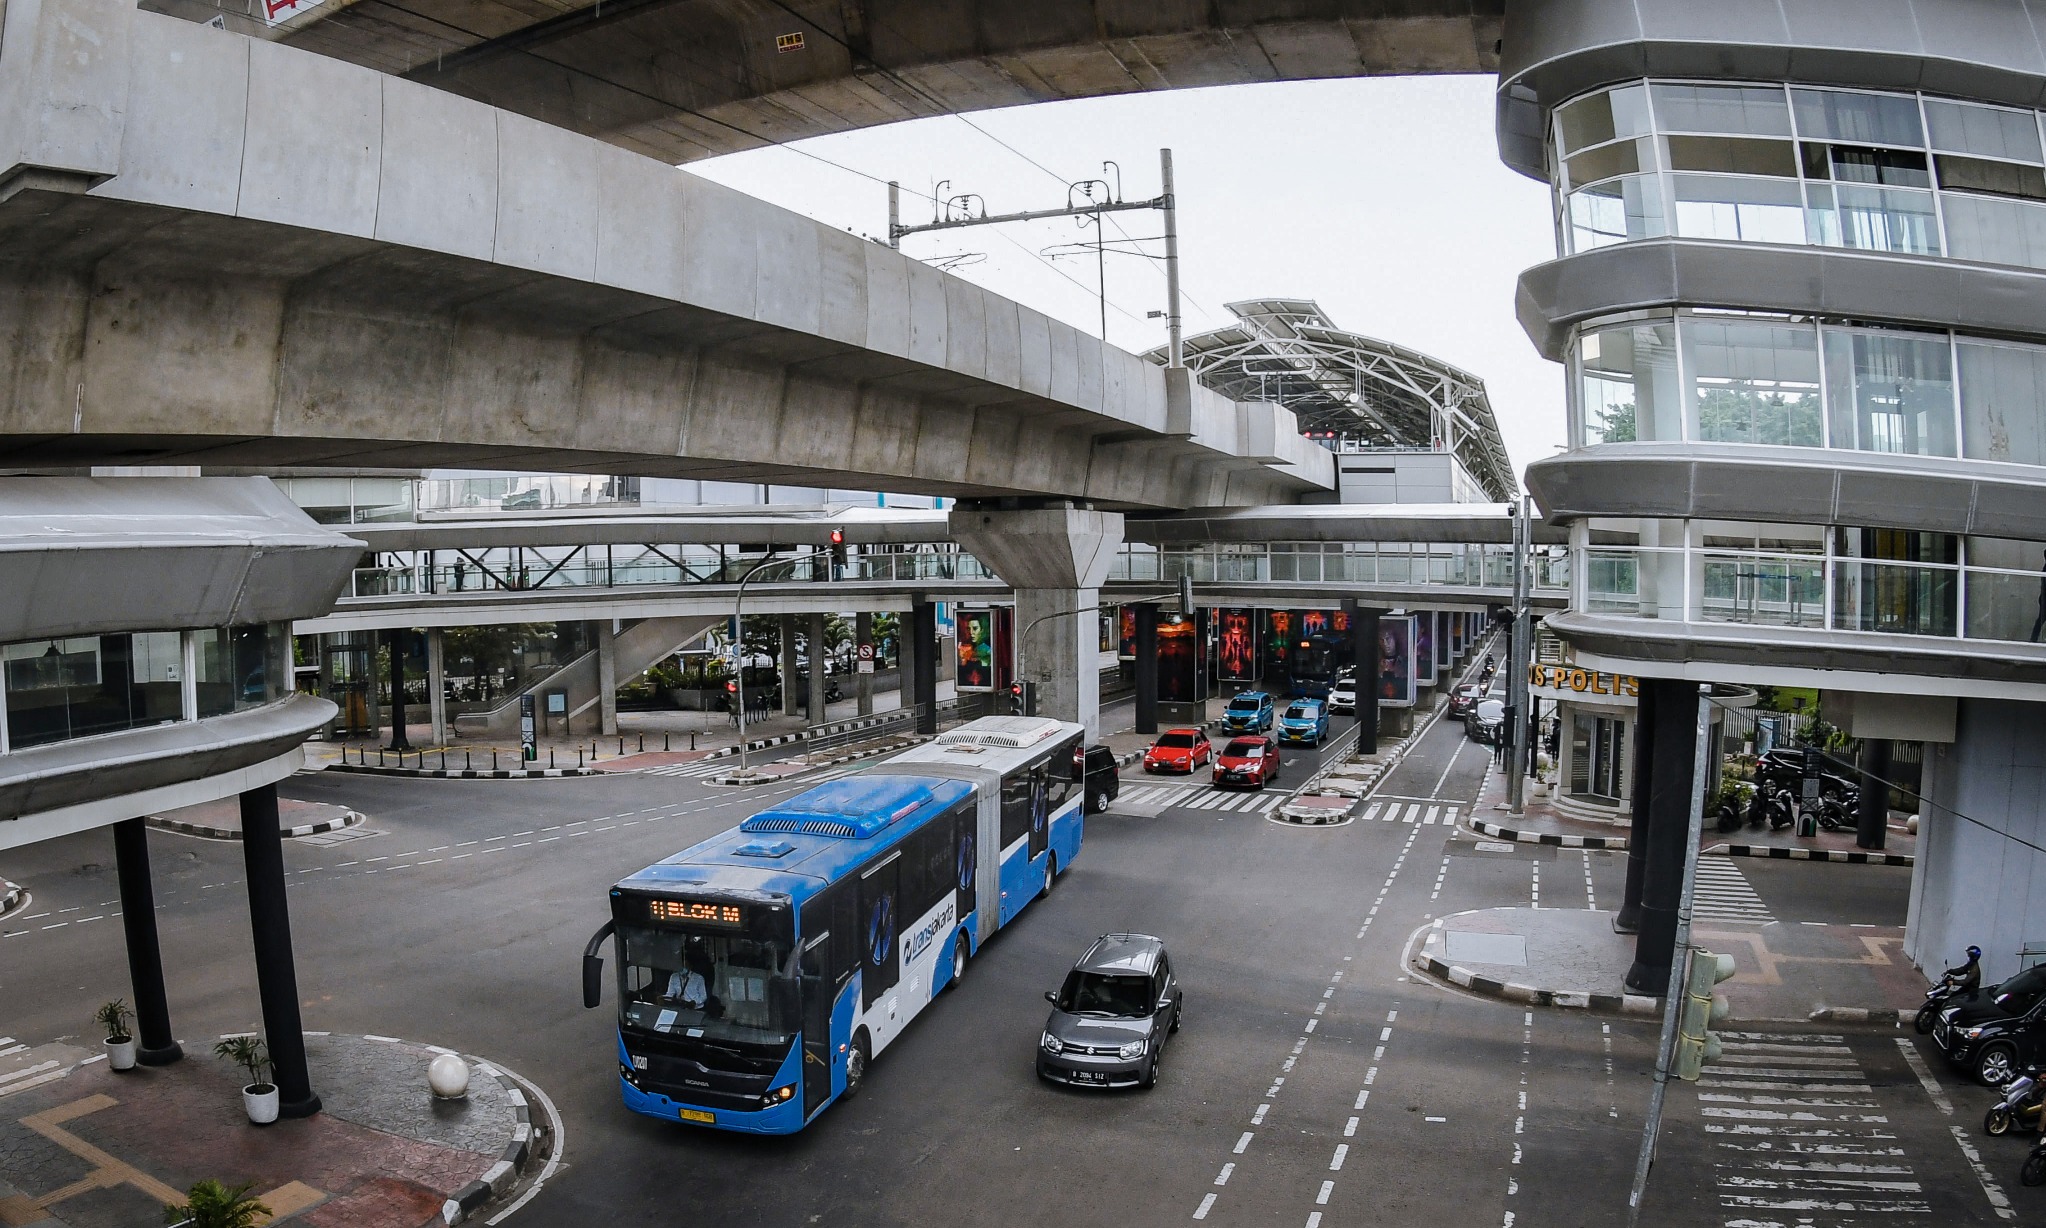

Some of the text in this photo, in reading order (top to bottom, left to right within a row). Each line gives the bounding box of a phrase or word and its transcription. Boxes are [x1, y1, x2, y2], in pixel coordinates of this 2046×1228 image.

[667, 902, 718, 919] BLOK
[722, 906, 740, 922] M
[912, 903, 954, 958] transjakarta
[685, 1079, 710, 1087] SCANIA
